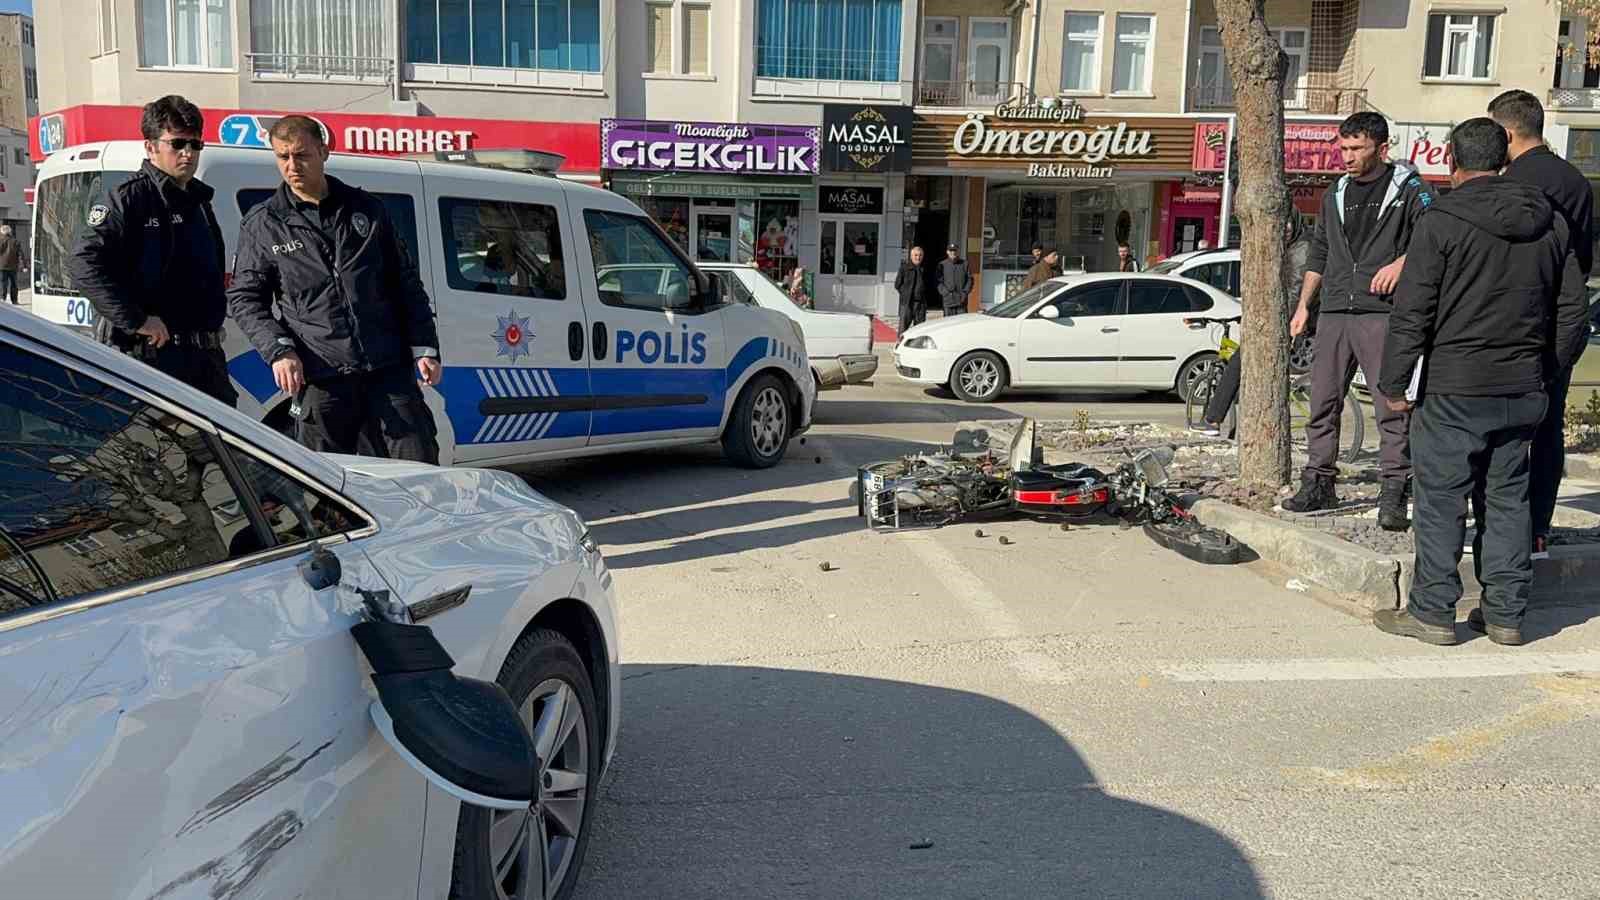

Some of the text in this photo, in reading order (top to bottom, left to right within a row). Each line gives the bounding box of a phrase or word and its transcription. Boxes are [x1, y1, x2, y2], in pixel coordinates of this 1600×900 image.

[996, 104, 1080, 122] Gaziantepli
[344, 126, 473, 152] MARKET
[674, 123, 750, 140] Moonlight
[828, 124, 905, 143] MASAL
[953, 113, 1152, 163] Ömeroğlu
[1027, 163, 1113, 178] Baklavaları
[828, 193, 873, 204] MASAL
[67, 299, 96, 325] POL
[616, 323, 707, 364] POLİS
